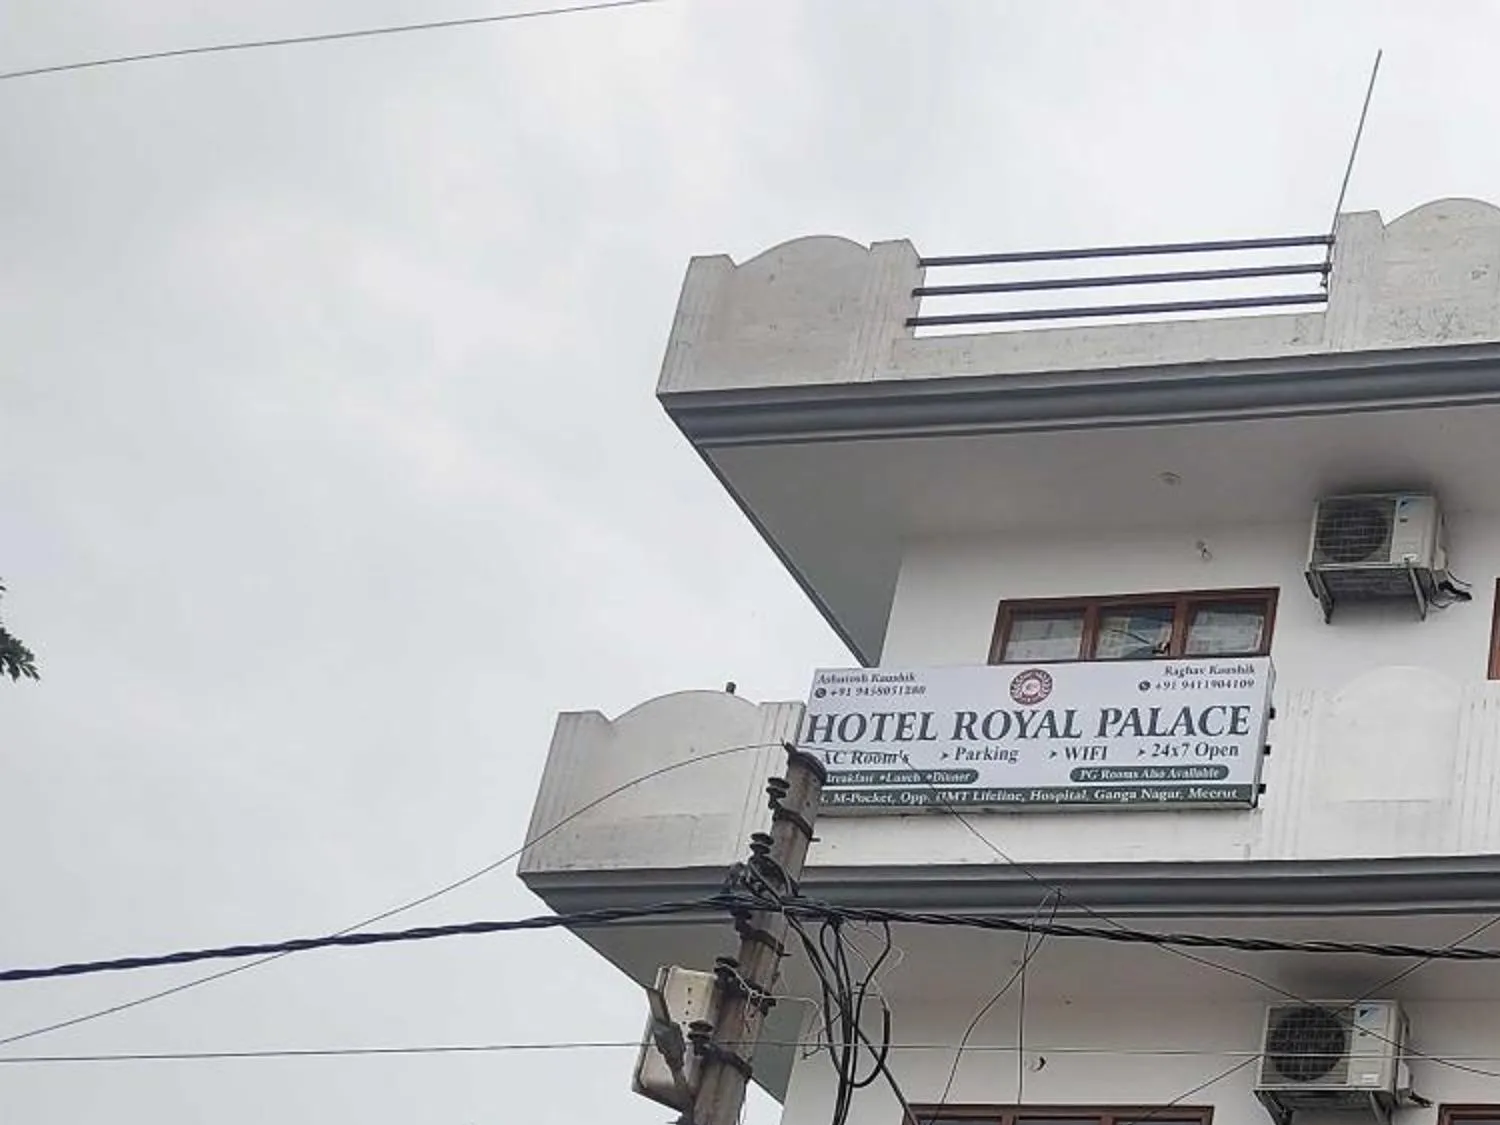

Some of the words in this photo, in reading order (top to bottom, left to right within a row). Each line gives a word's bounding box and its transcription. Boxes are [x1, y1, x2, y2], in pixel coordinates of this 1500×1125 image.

[805, 711, 938, 743] HOTEL
[950, 708, 1082, 741] ROYAL
[1094, 705, 1251, 739] PALACE
[955, 746, 1020, 764] Parking
[1065, 745, 1107, 760] WIFI
[1151, 743, 1191, 757] 24x7
[1195, 742, 1239, 760] Open
[1094, 788, 1137, 802] Ganga
[1188, 786, 1238, 799] Meerut
